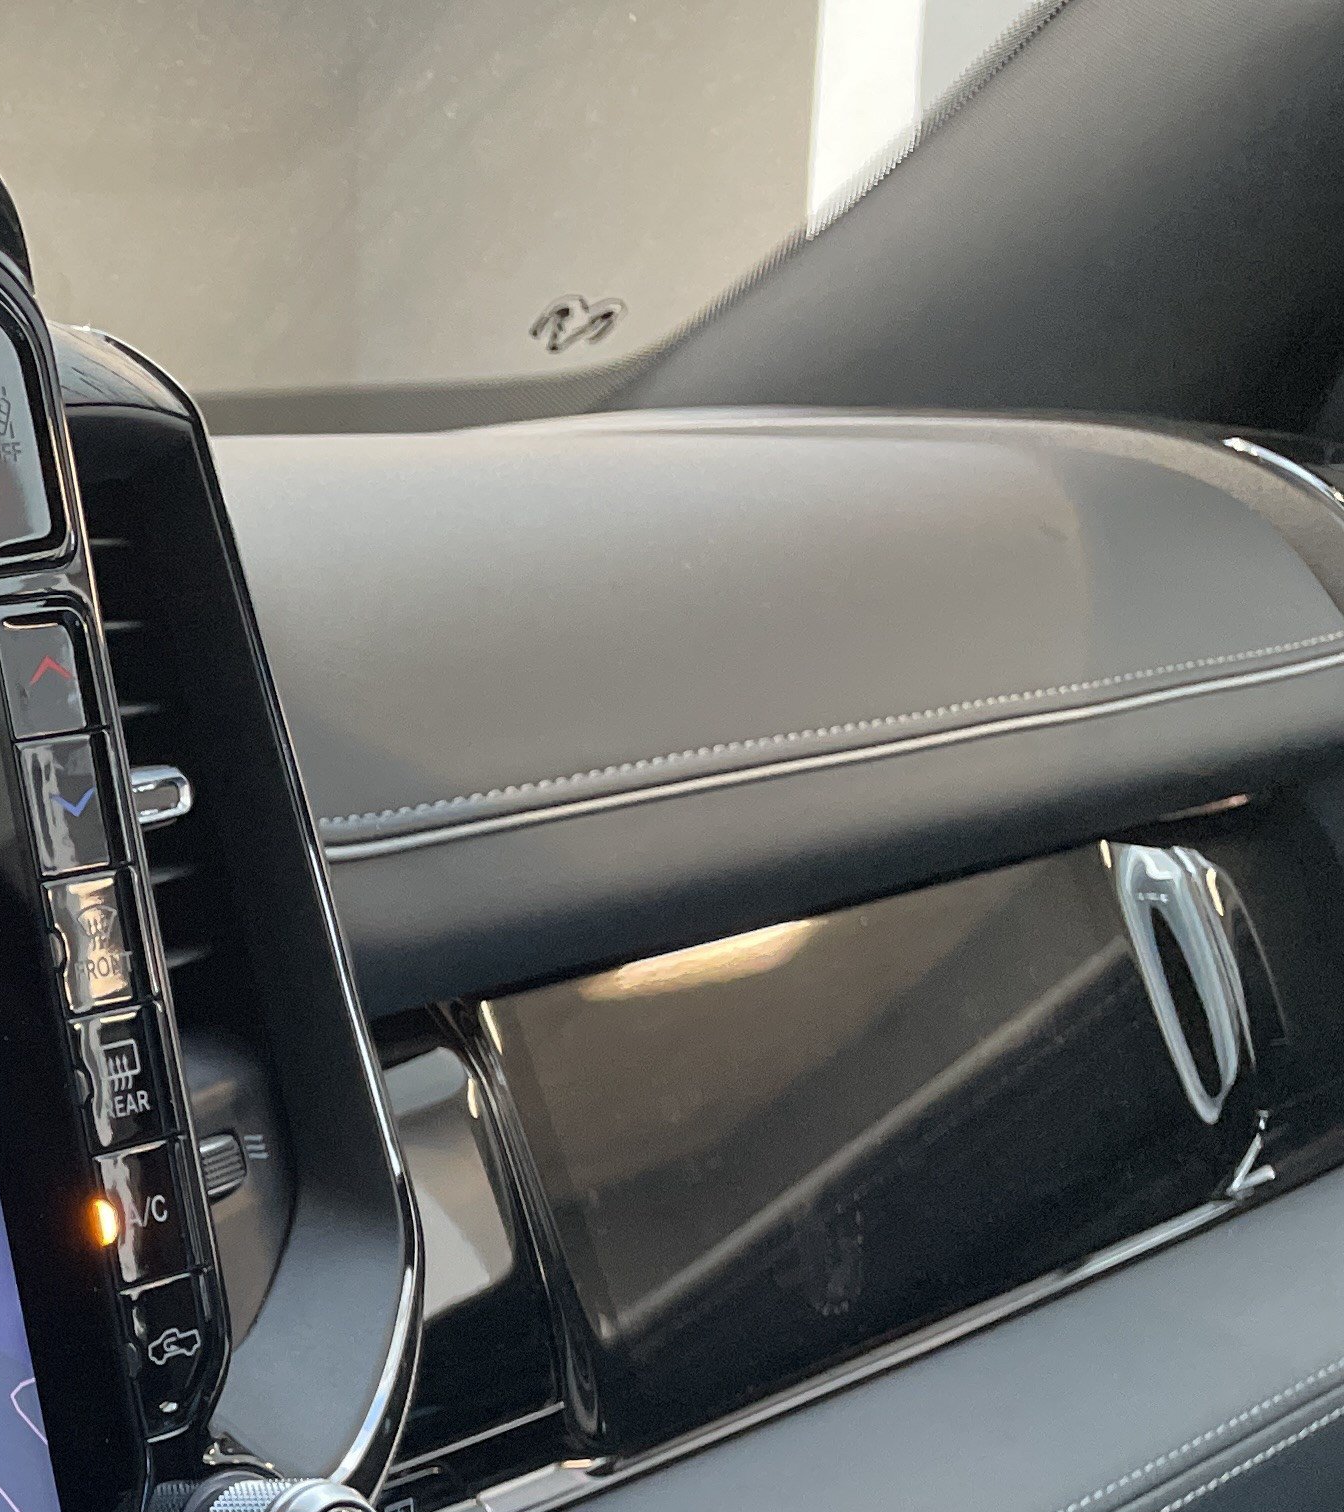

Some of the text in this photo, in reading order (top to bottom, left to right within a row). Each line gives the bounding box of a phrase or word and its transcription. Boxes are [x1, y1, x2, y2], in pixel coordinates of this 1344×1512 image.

[74, 950, 133, 979] FRONT
[104, 1090, 151, 1119] REAR
[128, 1193, 168, 1229] A/C
